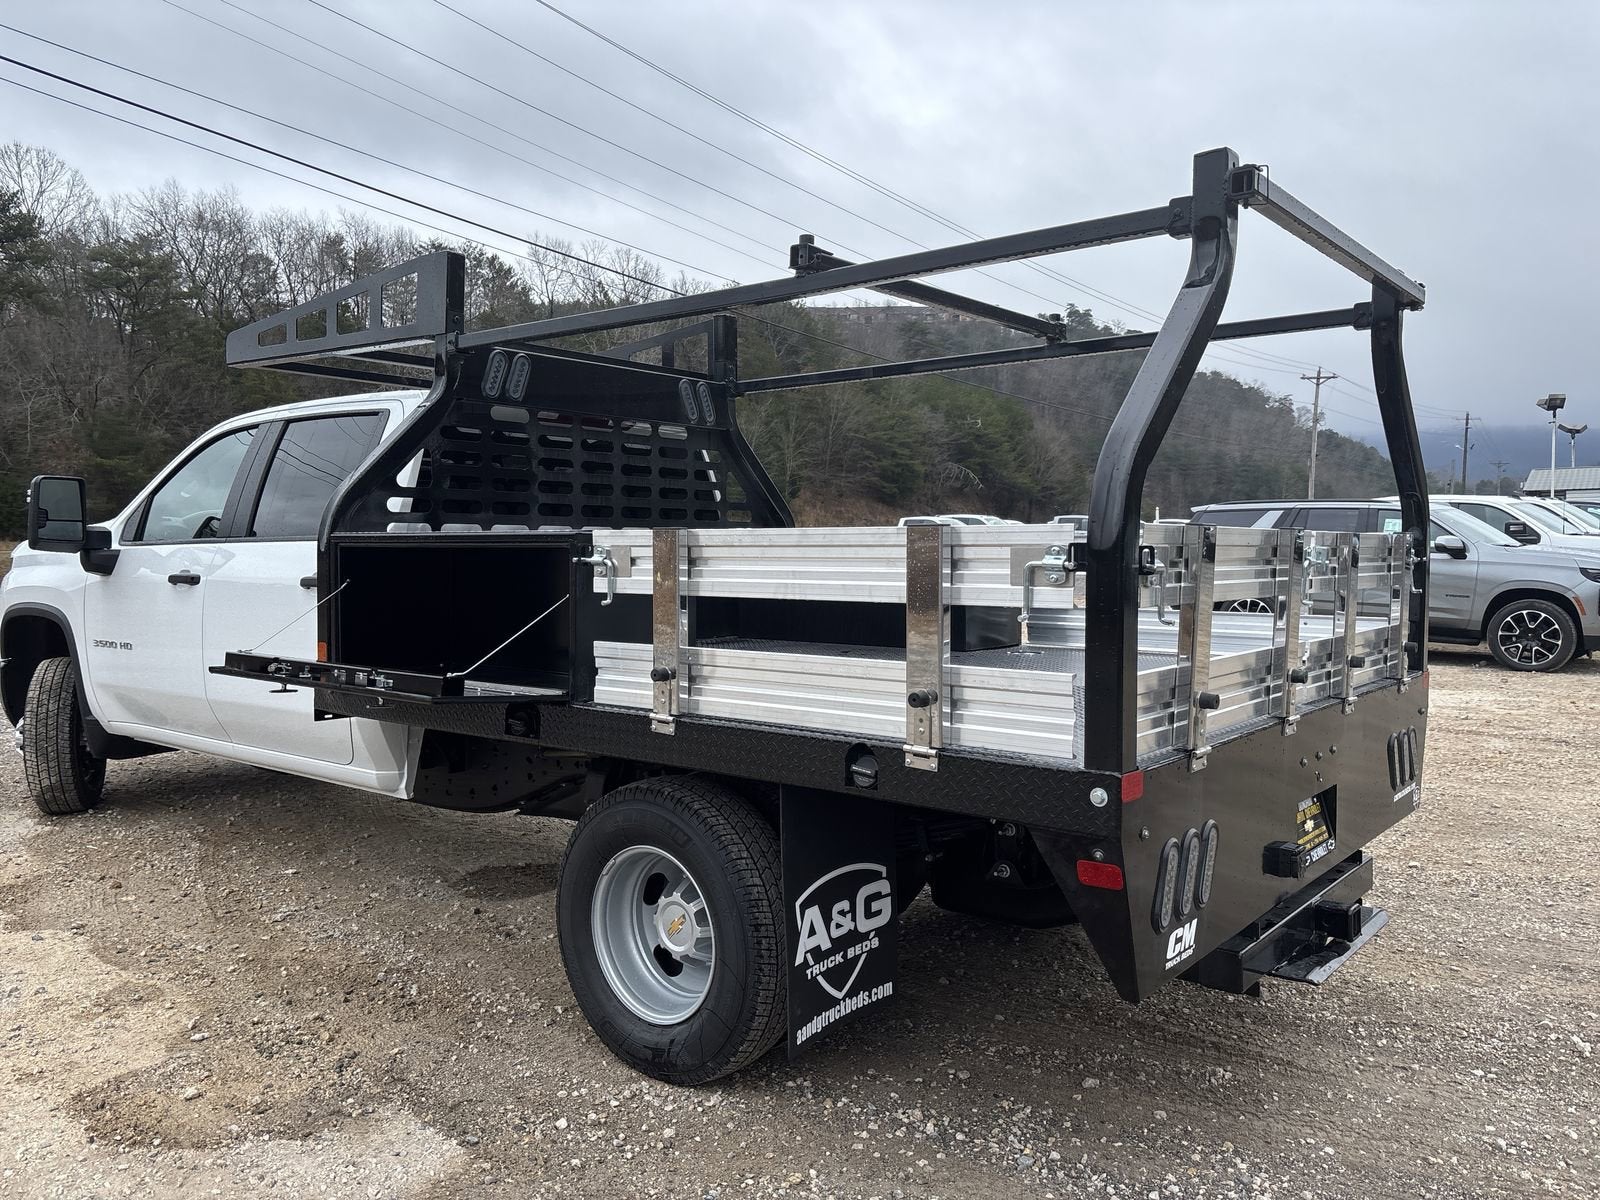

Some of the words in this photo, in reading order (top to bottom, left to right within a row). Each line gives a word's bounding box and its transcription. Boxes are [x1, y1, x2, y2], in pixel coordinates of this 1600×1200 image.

[93, 639, 118, 649] 3500
[119, 641, 133, 651] HD
[795, 879, 892, 966] A&G
[1166, 917, 1198, 960] CM
[806, 951, 844, 980] TRUCK
[847, 936, 879, 959] BEDS
[796, 981, 893, 1045] aandgtruckbeds.com
